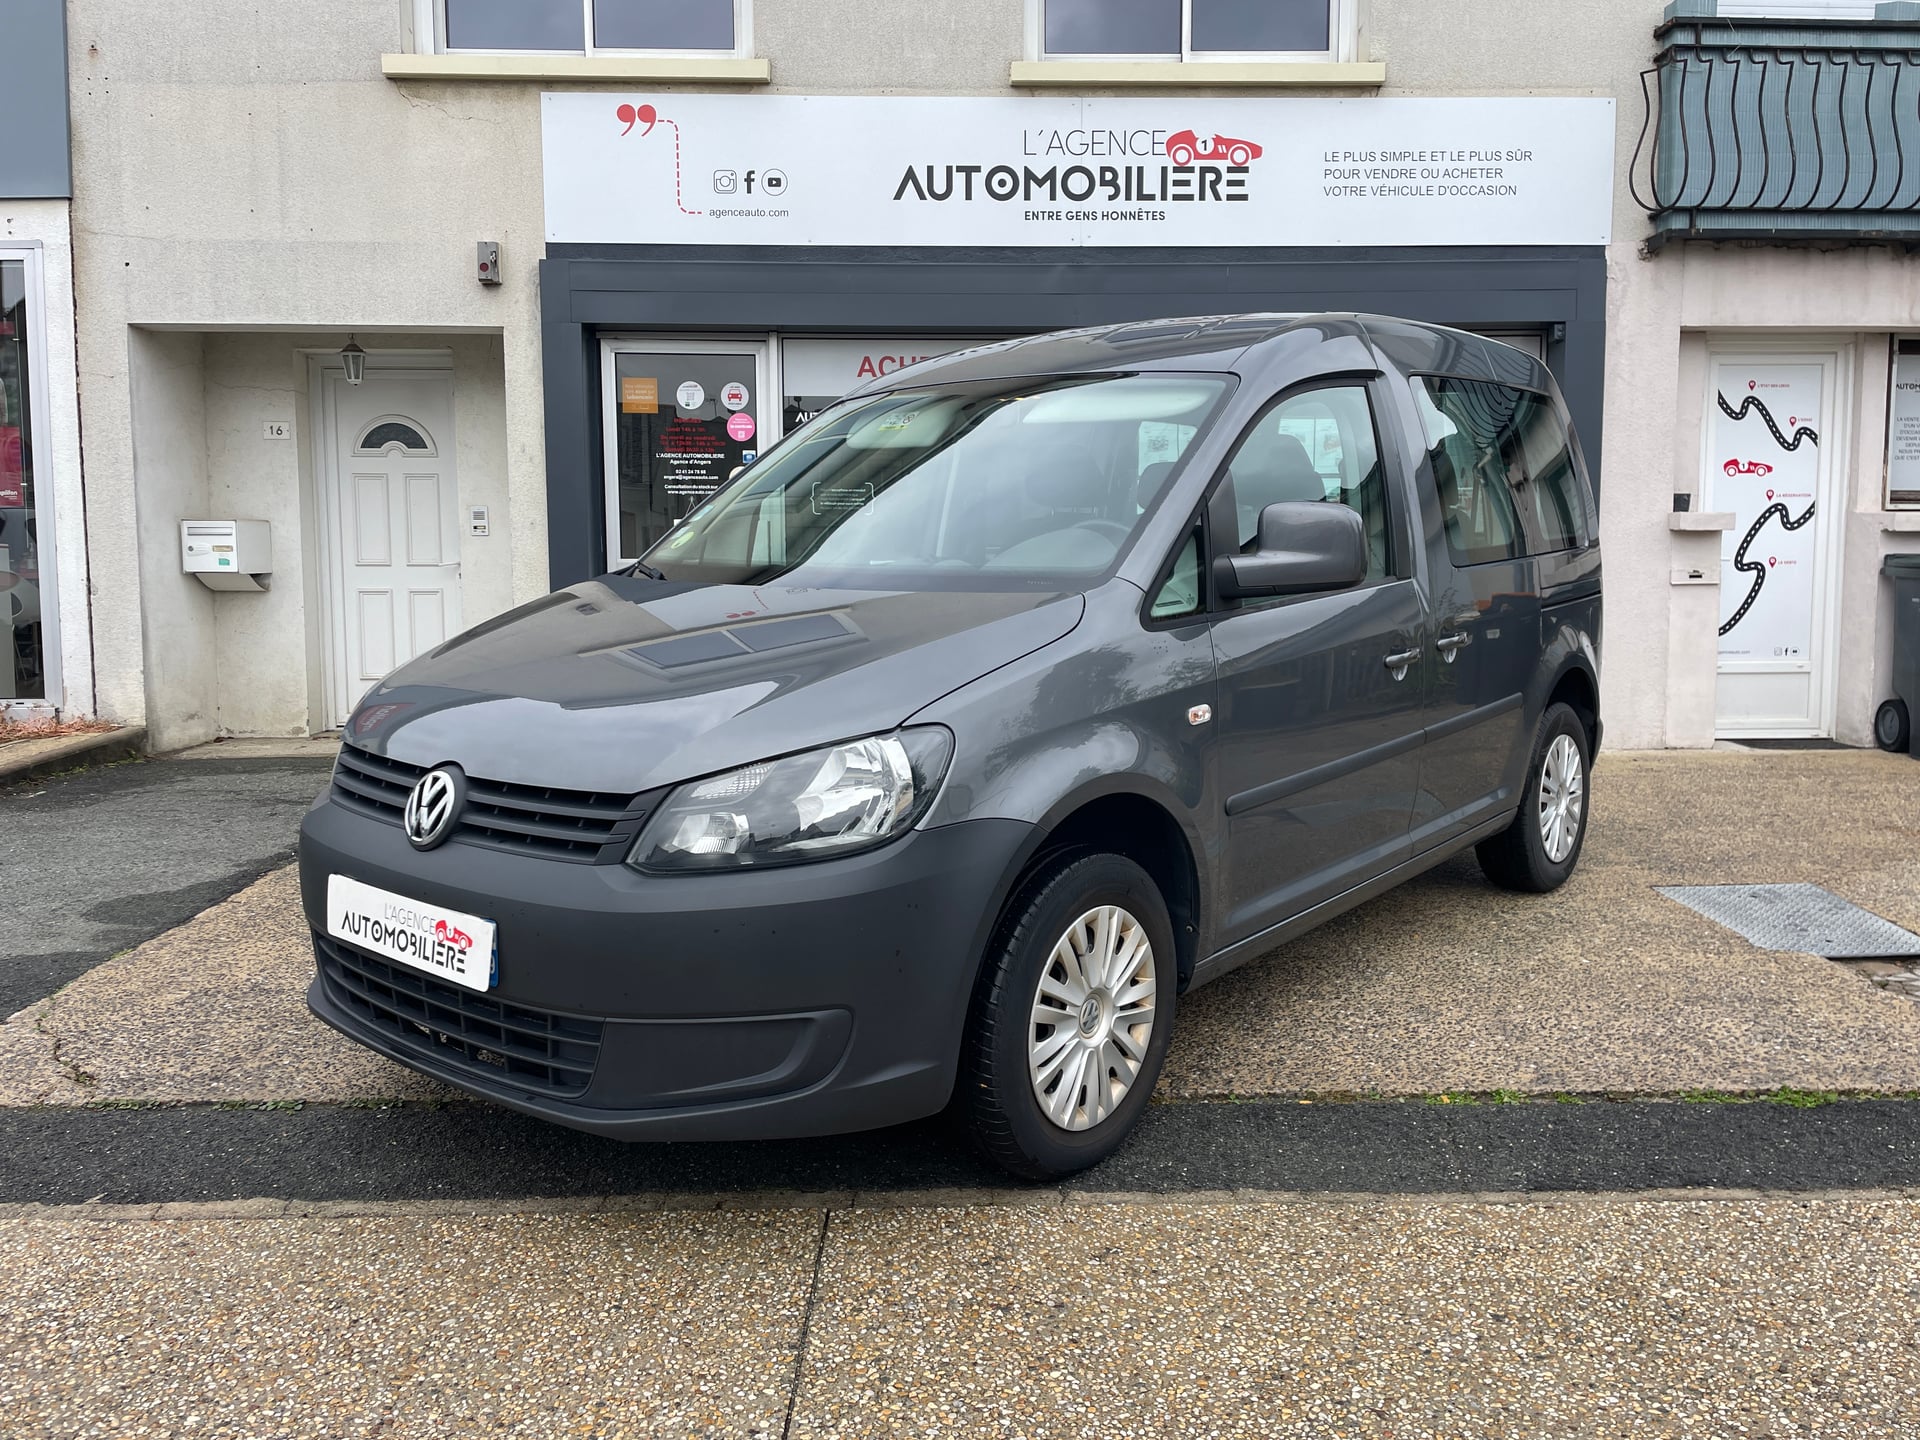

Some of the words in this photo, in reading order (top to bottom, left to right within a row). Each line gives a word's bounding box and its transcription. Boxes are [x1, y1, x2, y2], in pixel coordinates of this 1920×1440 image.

[1023, 129, 1167, 156] L'AGENCE
[1201, 139, 1208, 151] 1
[1324, 152, 1340, 162] LE
[1343, 151, 1377, 162] PLUS
[1380, 151, 1427, 162] SIMPLE
[1430, 151, 1447, 161] ET
[1450, 151, 1465, 161] LE
[1469, 150, 1502, 162] PLUS
[1505, 149, 1533, 161] SÛR
[1324, 168, 1361, 180] POUR
[1364, 168, 1417, 179] VENDRE
[1420, 168, 1440, 179] OU
[1442, 168, 1504, 179] ACHETER
[1323, 186, 1367, 197] VOTRE
[1371, 184, 1434, 196] VÉHICULE
[1438, 185, 1517, 196] D'OCCASION
[708, 207, 790, 219] agenceauto.com
[1024, 210, 1063, 221] ENTRE
[1065, 210, 1098, 221] GENS
[1101, 208, 1166, 221] HONNÊTES
[857, 355, 929, 378] AC
[269, 425, 283, 436] 16
[384, 902, 437, 936] L'AGENCE
